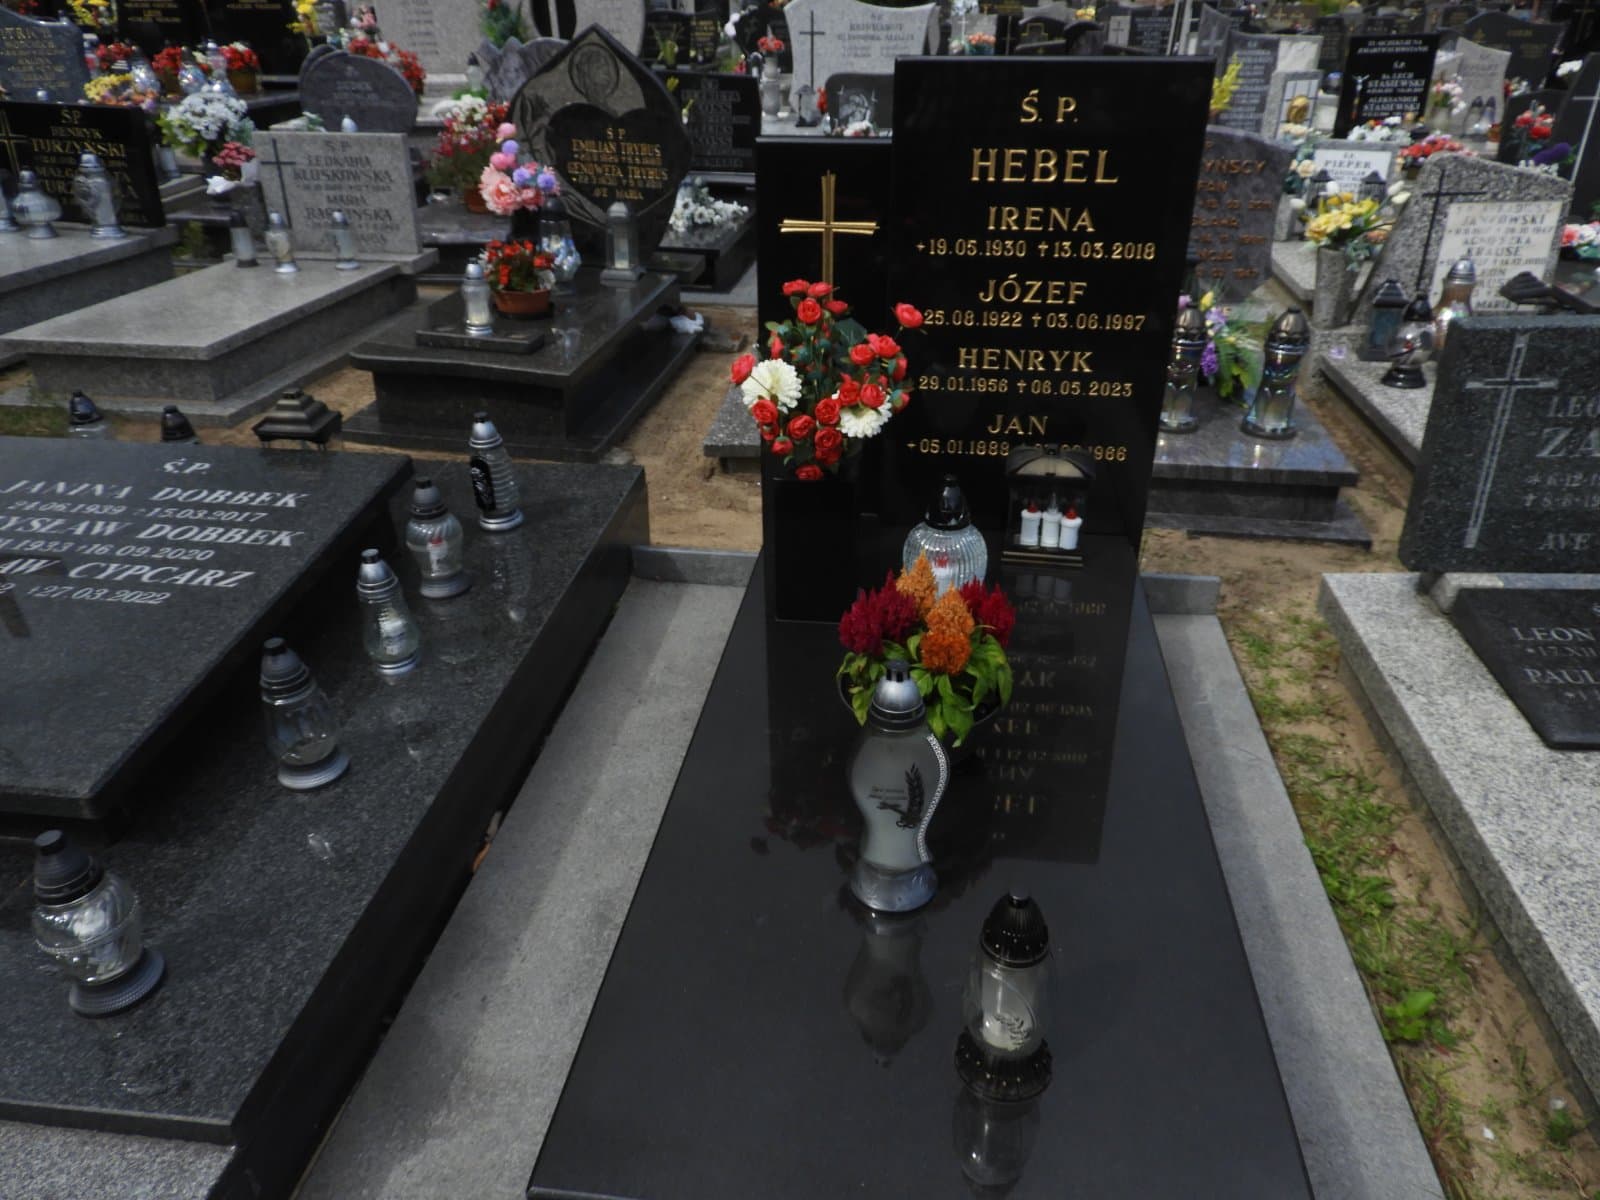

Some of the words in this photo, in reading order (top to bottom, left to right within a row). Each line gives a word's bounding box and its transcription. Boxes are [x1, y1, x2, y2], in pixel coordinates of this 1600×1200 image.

[1056, 97, 1079, 122] P.
[971, 149, 1118, 183] HEBEL
[1324, 159, 1372, 169] PIEPER
[987, 206, 1095, 232] IRENA
[929, 239, 1027, 258] 19.05.1930
[1053, 241, 1157, 260] 13.03.2018
[978, 273, 1088, 305] JÓZEF
[923, 310, 1023, 328] 25.08.1922
[1046, 313, 1147, 331] 03.06.1997
[958, 347, 1094, 374] HENRYK
[918, 375, 1009, 393] 29.01.1956
[1030, 379, 1134, 398] 06.05.2023
[987, 414, 1049, 436] JAN
[149, 487, 312, 508] DOBBEK
[135, 523, 305, 546] DOBBEK
[1537, 532, 1592, 551] AVE
[68, 561, 257, 588] CYPCARZ
[1511, 626, 1596, 642] LEON
